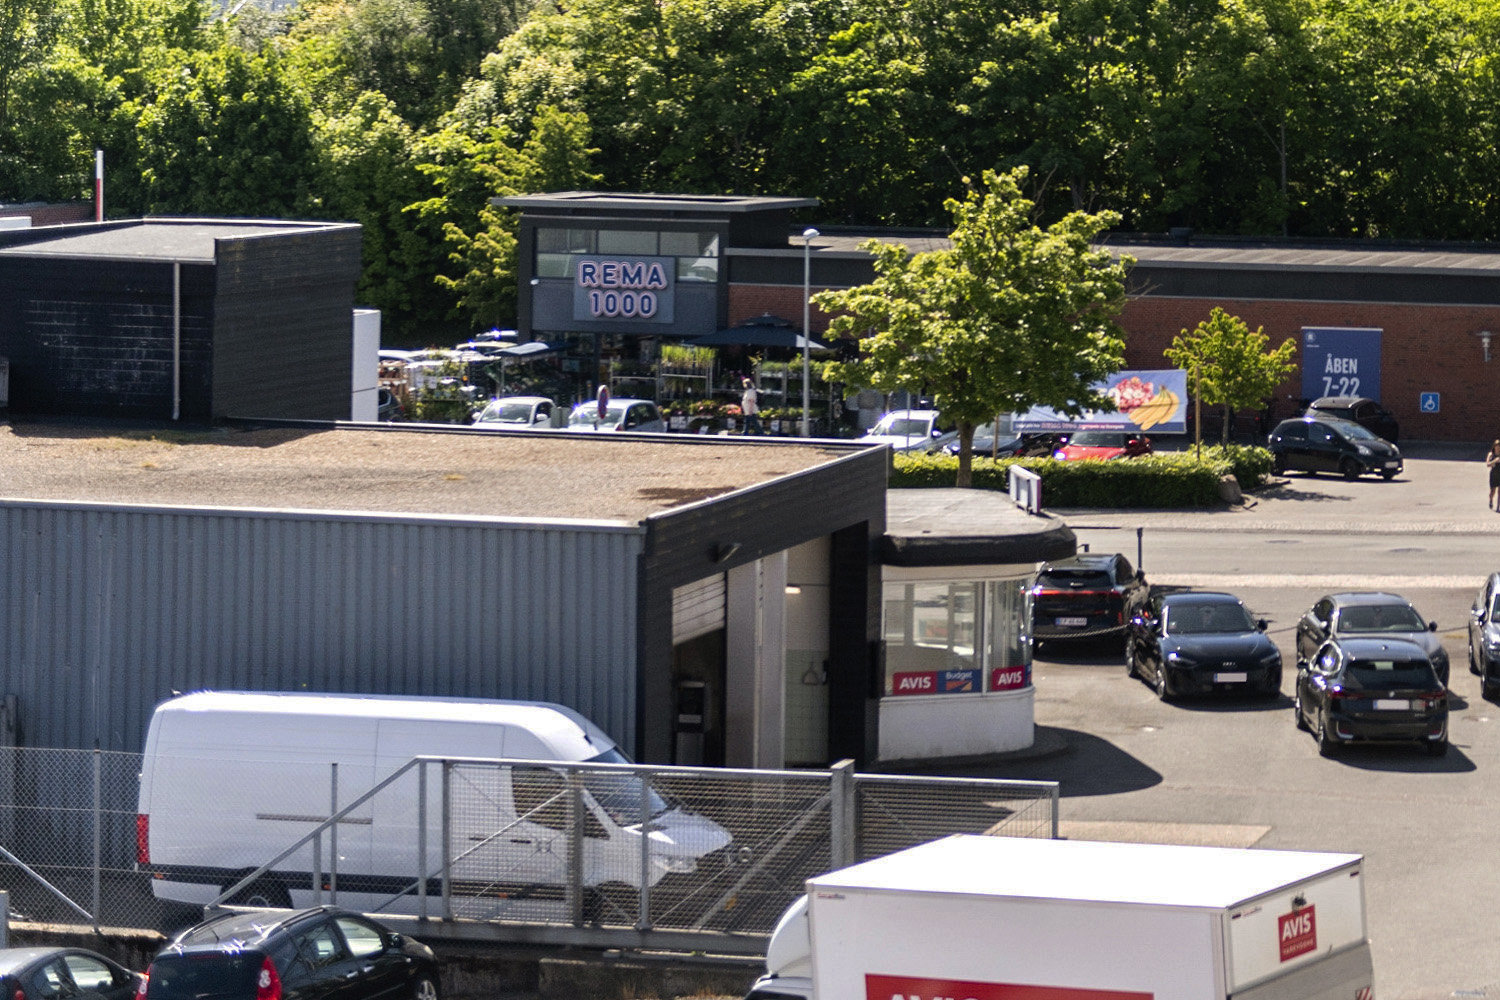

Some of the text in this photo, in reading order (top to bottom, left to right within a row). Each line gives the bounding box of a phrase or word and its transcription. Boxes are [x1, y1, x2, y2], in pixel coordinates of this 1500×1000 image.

[580, 262, 665, 288] REMA
[590, 291, 655, 317] 1000
[1325, 353, 1358, 374] ÅBEN
[1322, 376, 1360, 398] 7-22
[899, 676, 932, 690] AVIS
[945, 671, 973, 680] Budget
[998, 671, 1022, 686] AVIS
[1282, 913, 1311, 941] AVIS
